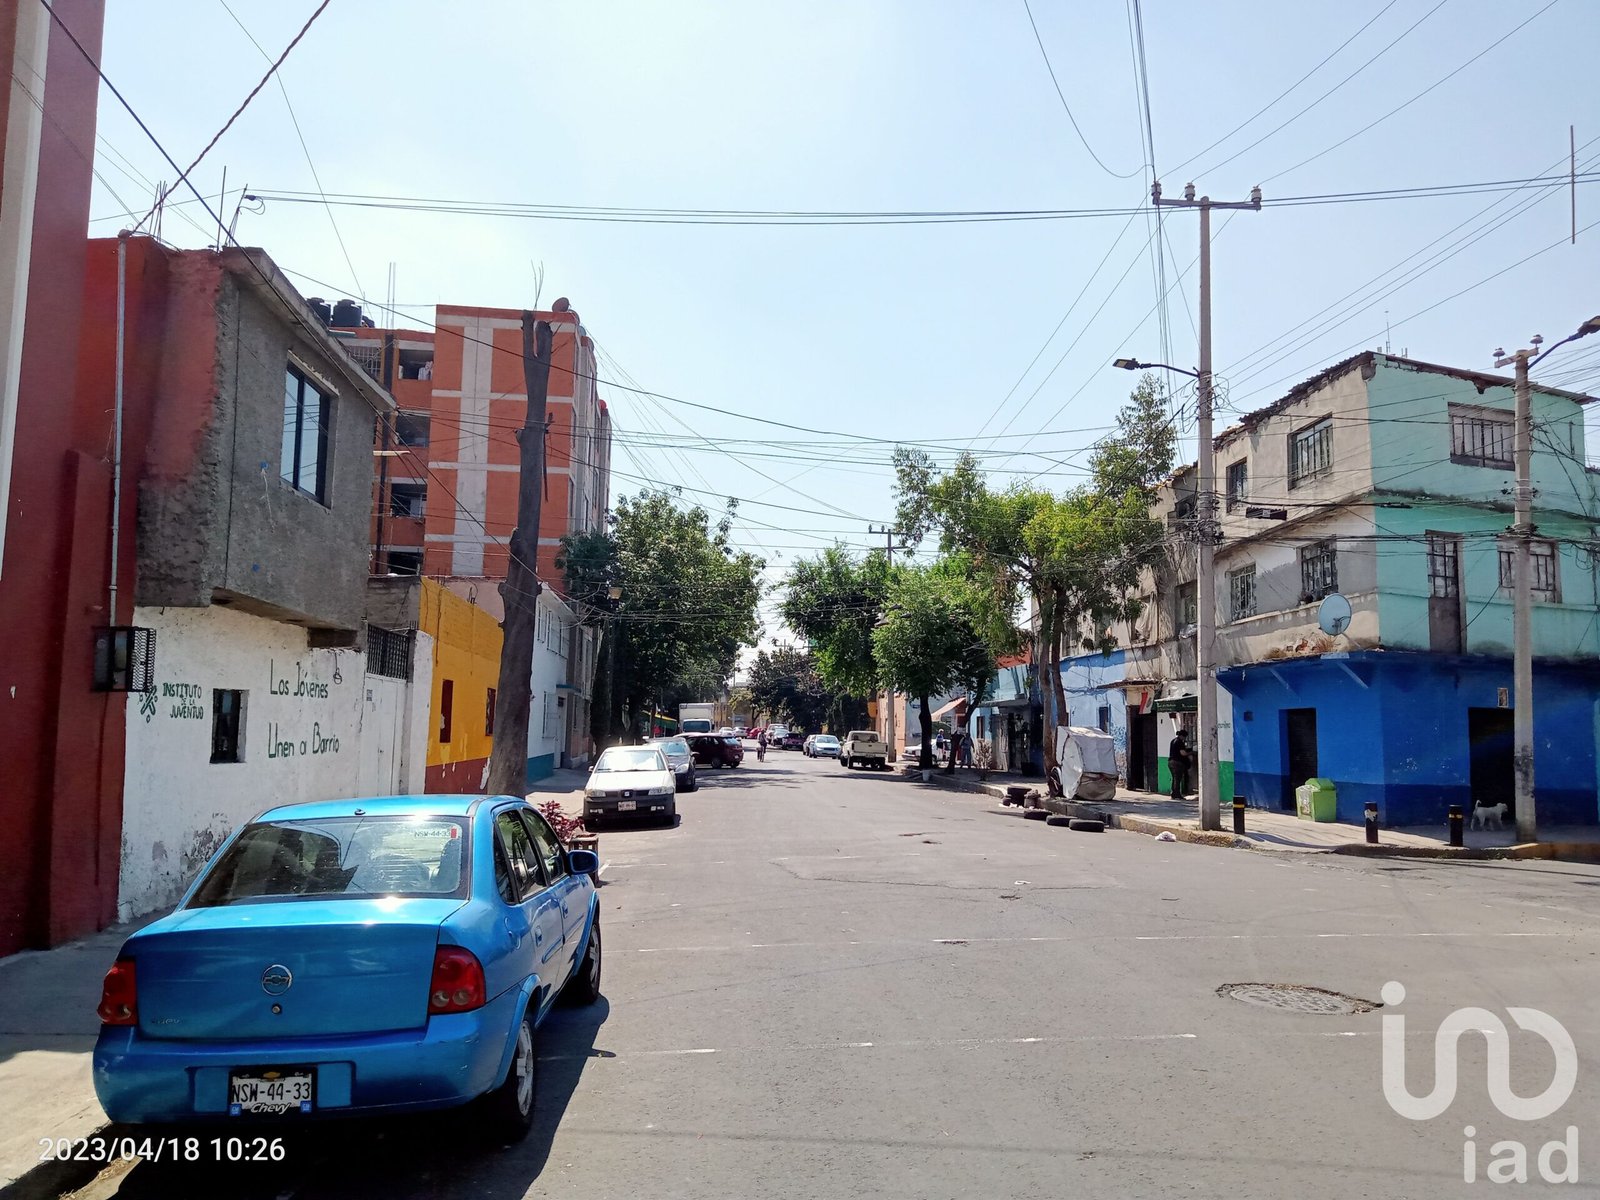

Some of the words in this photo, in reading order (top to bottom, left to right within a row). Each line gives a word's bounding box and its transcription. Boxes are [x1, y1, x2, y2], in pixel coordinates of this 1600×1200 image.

[270, 658, 290, 696] Los
[293, 661, 328, 699] Jóvenes
[162, 682, 202, 699] INSTITUTO
[181, 697, 187, 706] DE
[189, 698, 195, 706] LA
[170, 704, 204, 720] JUVENTUD
[268, 722, 295, 759] Unen
[299, 740, 307, 756] a
[312, 721, 340, 755] Barrio
[232, 1082, 310, 1103] NSW-44-33
[250, 1102, 292, 1115] Chevy
